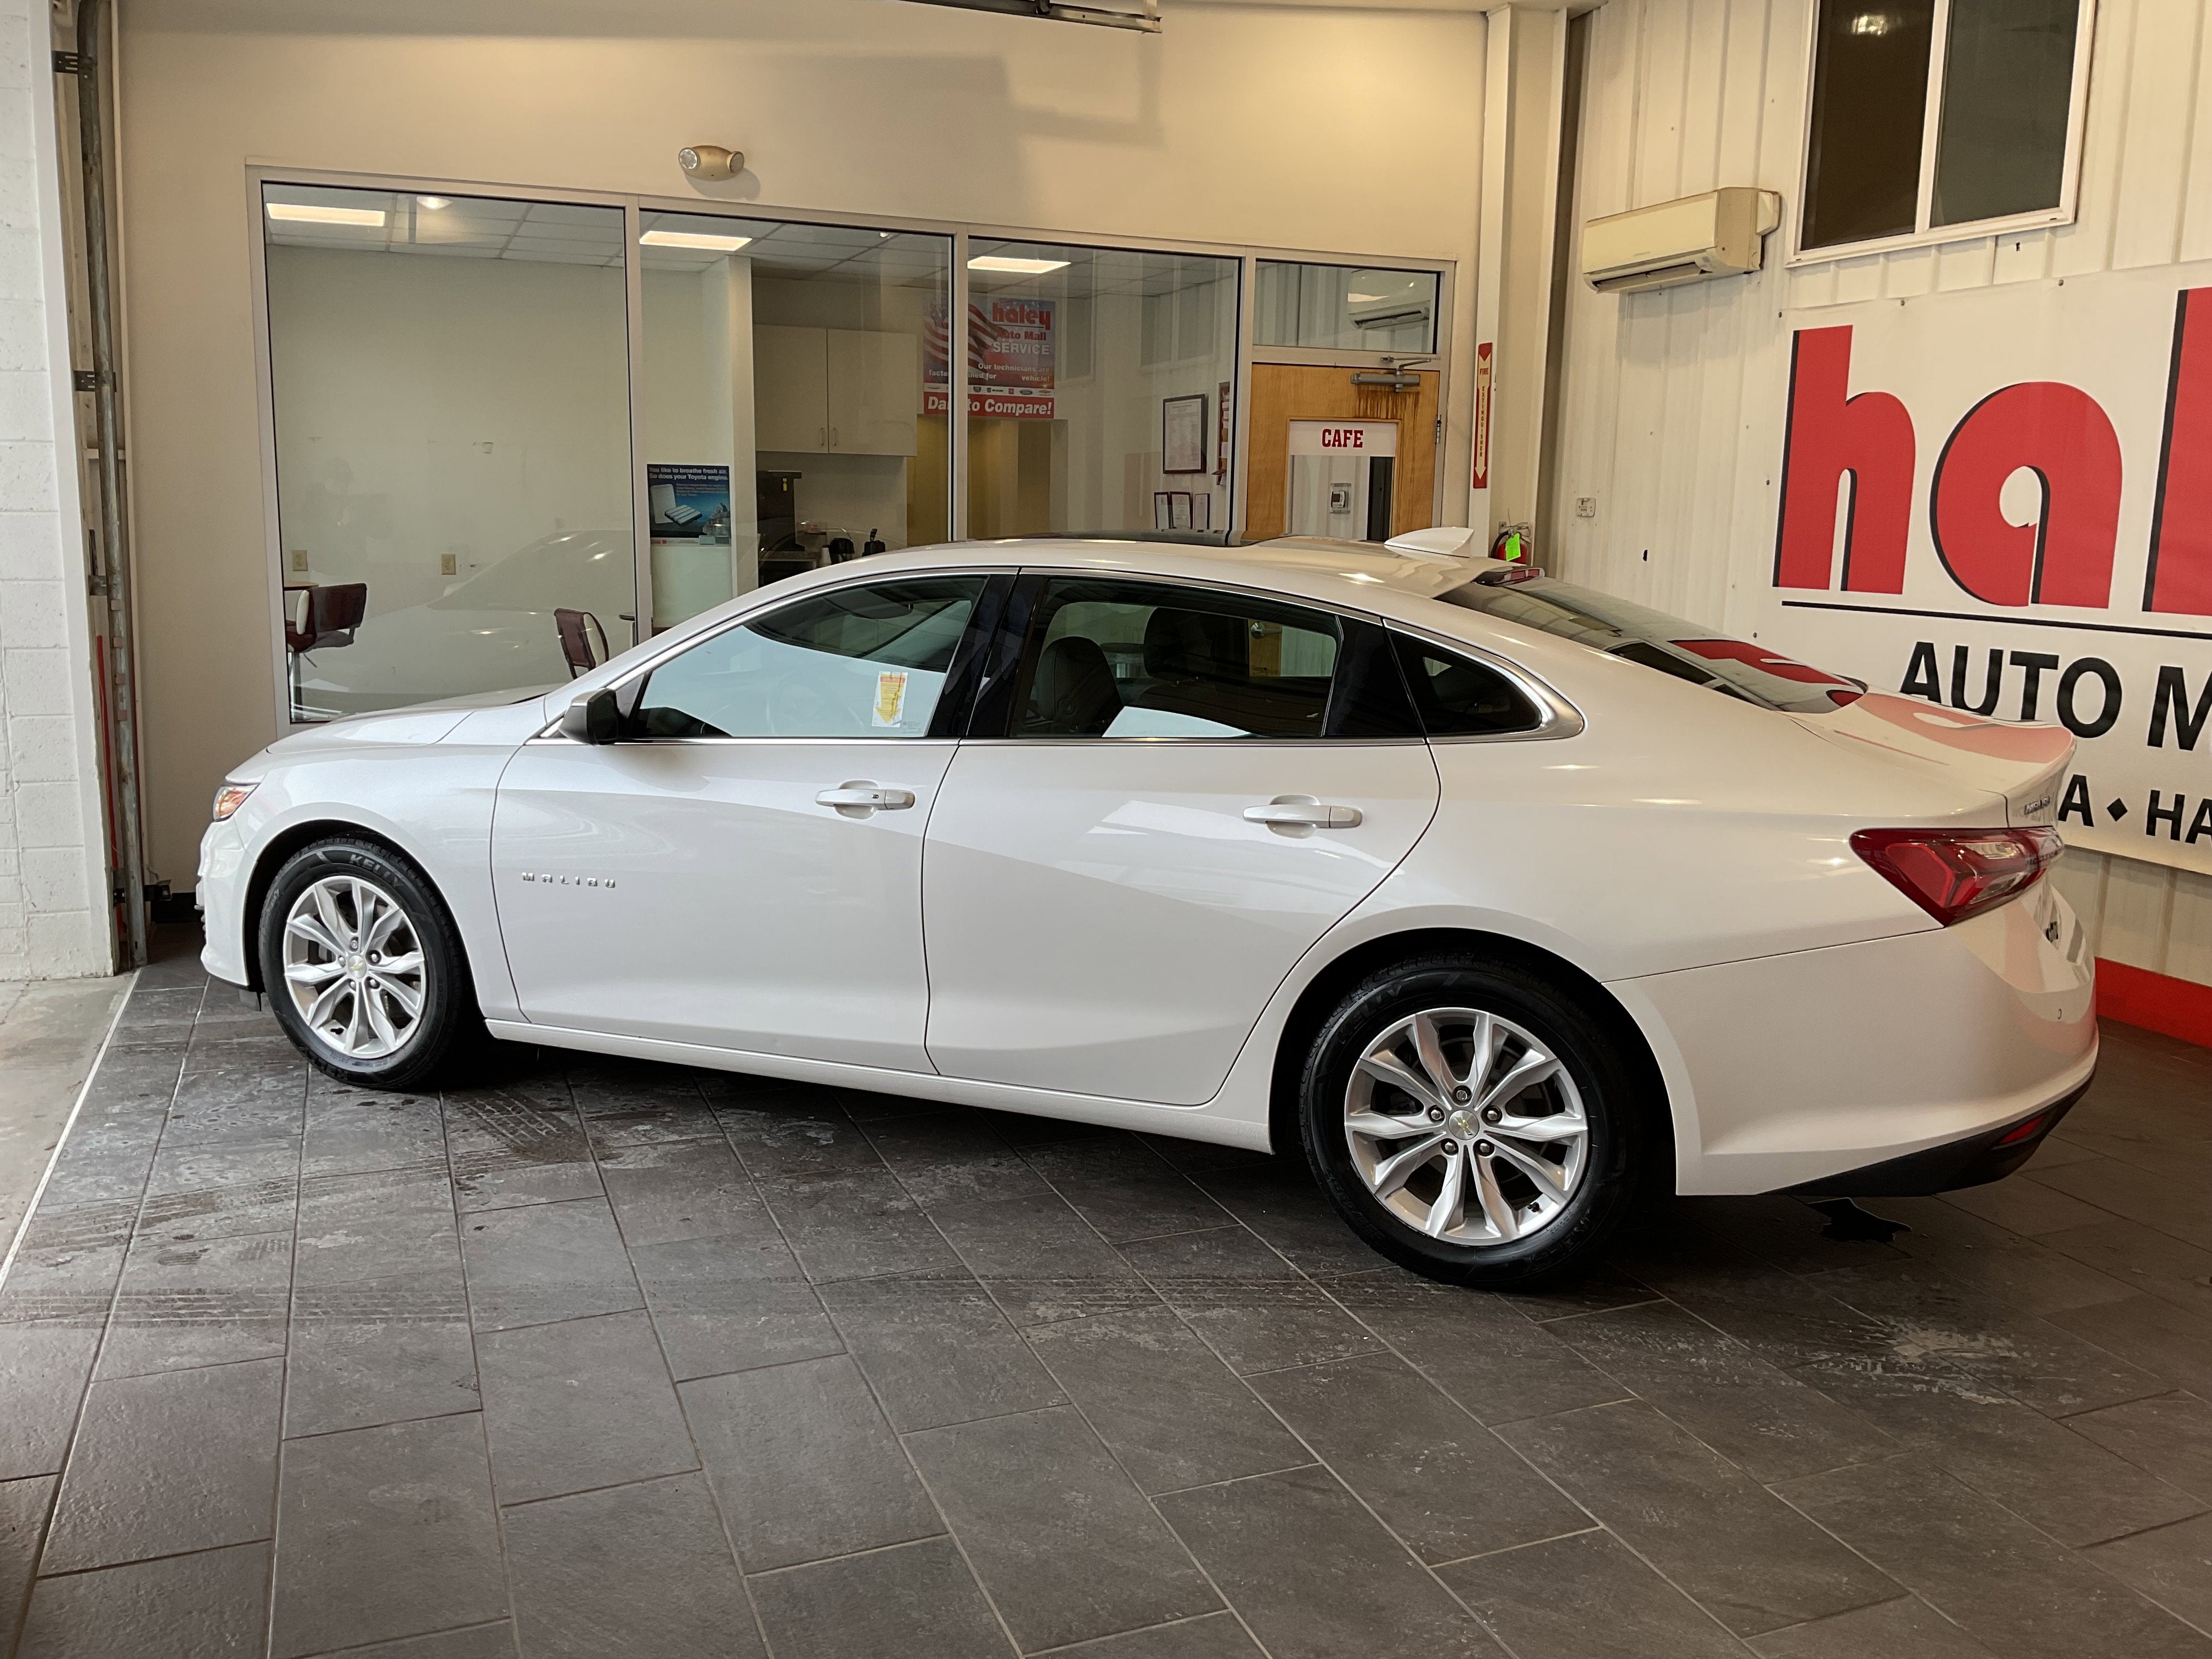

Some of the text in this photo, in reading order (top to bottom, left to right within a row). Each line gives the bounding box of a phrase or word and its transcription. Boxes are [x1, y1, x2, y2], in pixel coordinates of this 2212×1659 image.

[992, 302, 1051, 330] haley
[996, 330, 1046, 341] Auto Mall
[993, 342, 1049, 355] SERVICE
[994, 364, 1036, 372] technicians
[1479, 368, 1489, 376] FIRE
[928, 396, 949, 410] Da
[985, 399, 1052, 416] Compare!
[1322, 428, 1363, 448] CAFE
[1900, 641, 2122, 738] AUTO
[349, 854, 404, 888] KELLY
[522, 872, 616, 888] MALIBU
